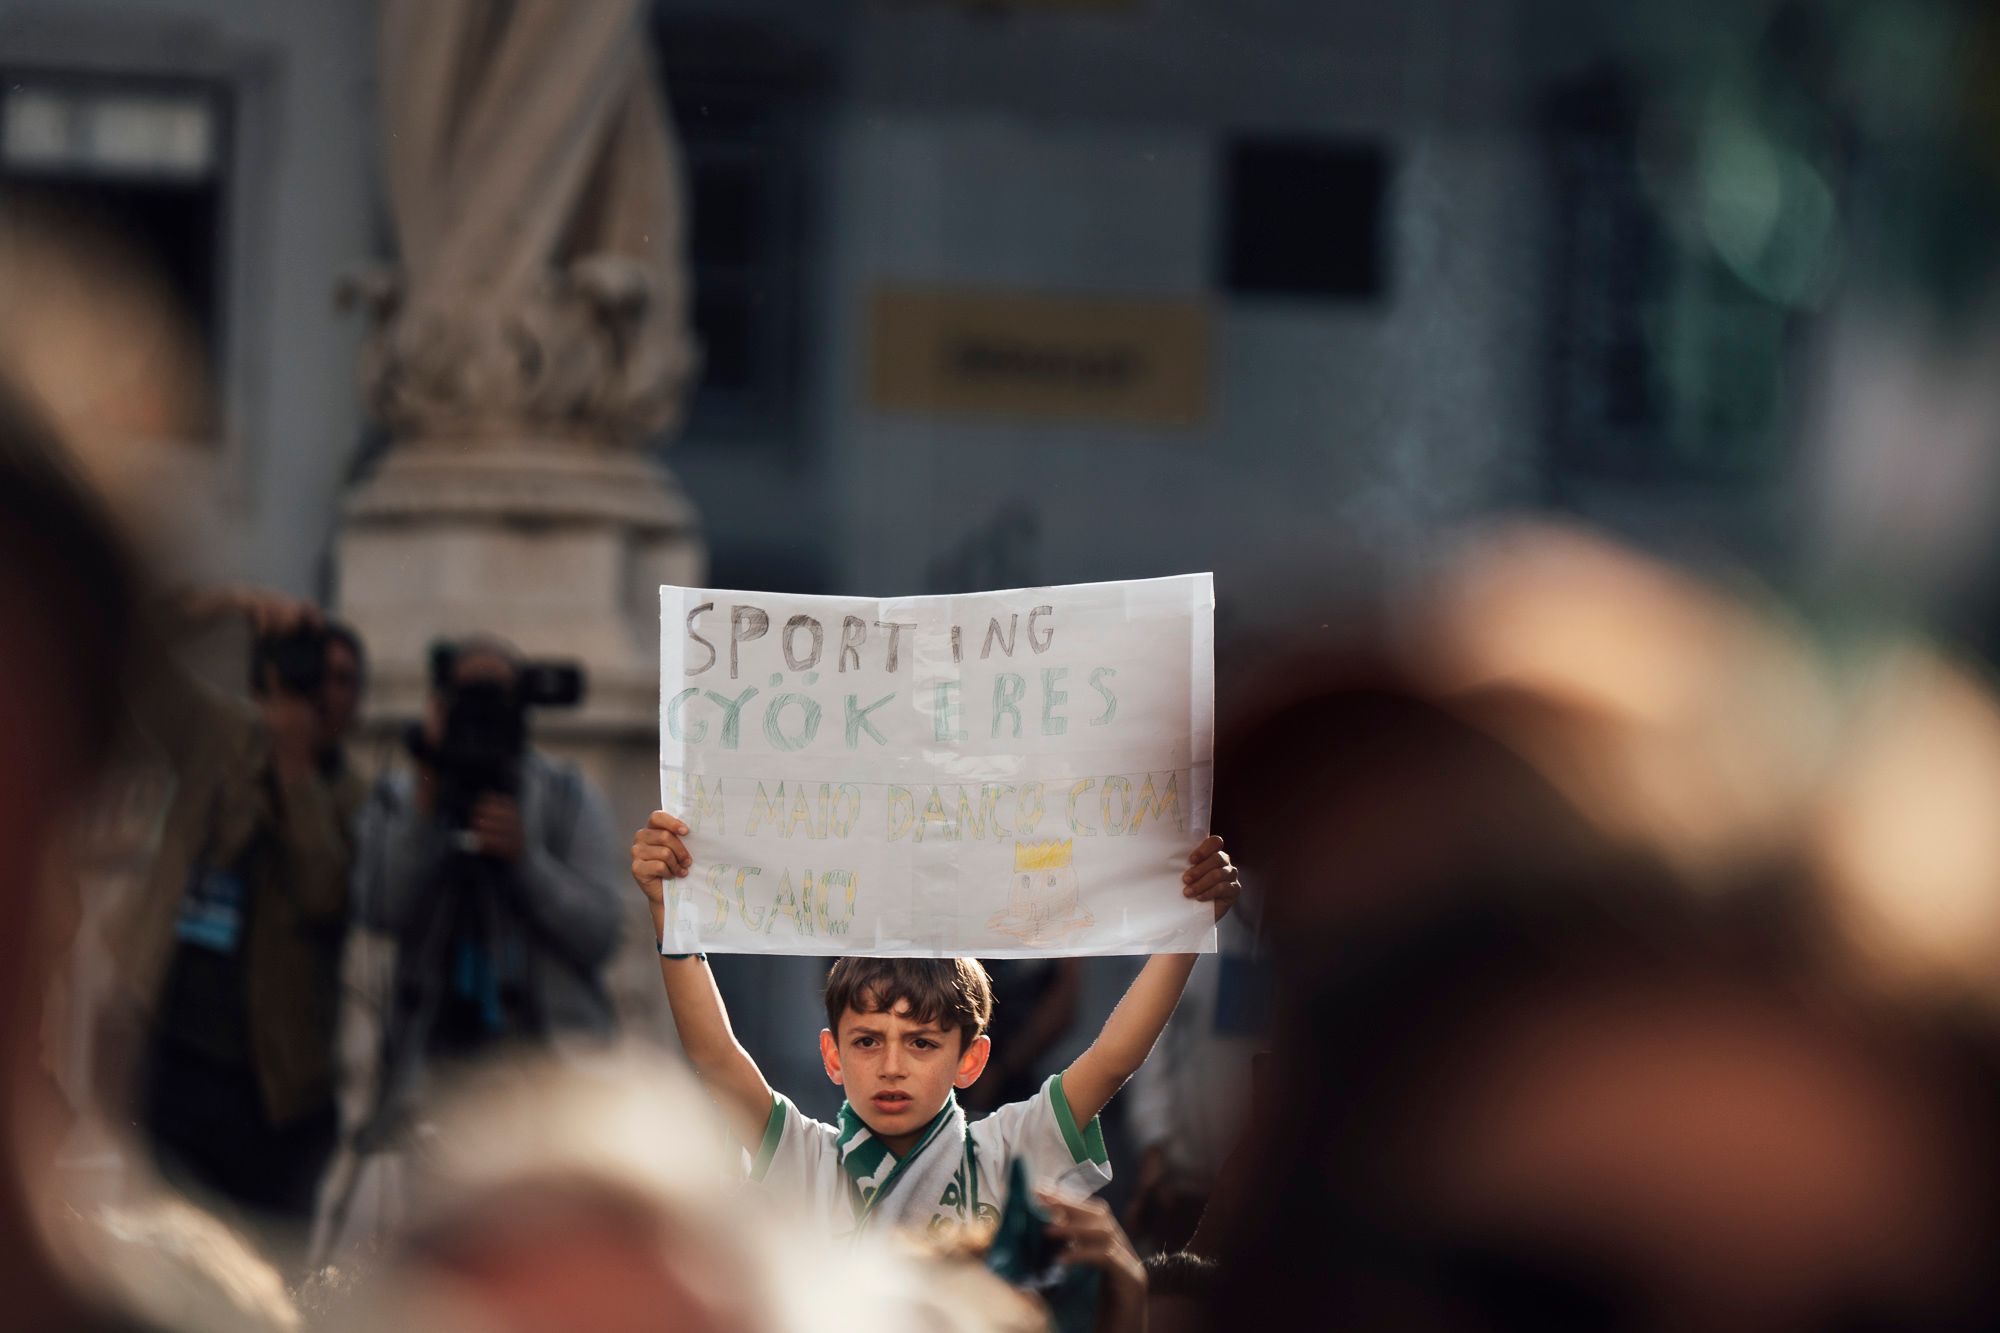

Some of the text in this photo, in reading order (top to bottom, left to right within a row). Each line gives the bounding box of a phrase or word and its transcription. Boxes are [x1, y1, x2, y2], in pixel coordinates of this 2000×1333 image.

[684, 602, 1054, 679] SPORTING
[668, 666, 1118, 751] GYÖKERES
[744, 780, 861, 840] MAIO
[1065, 769, 1184, 836] COM
